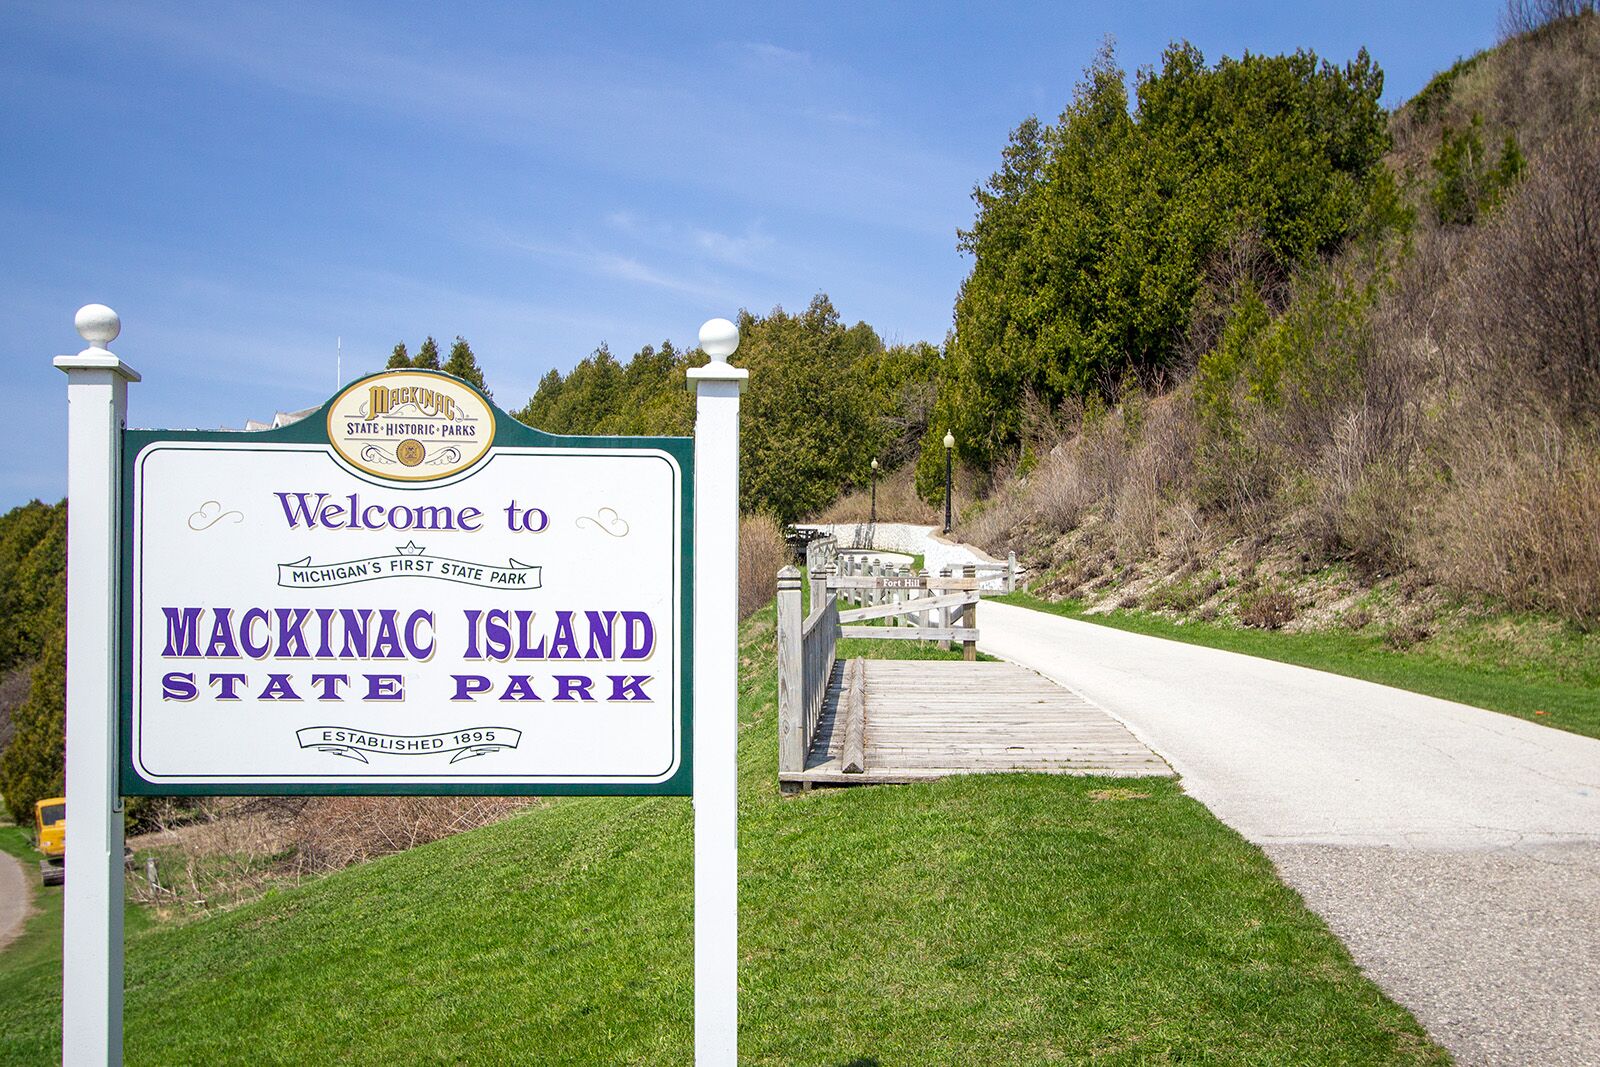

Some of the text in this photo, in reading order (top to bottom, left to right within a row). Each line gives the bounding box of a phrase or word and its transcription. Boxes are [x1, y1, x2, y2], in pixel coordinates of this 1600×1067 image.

[365, 385, 455, 421] MACKINAC
[347, 422, 476, 437] STATE HISTORIC PARKS
[273, 492, 550, 533] Welcome to
[292, 560, 527, 585] MICHIGAN'S FIRST STATE PARK
[883, 578, 920, 587] Fort Hill
[161, 607, 657, 662] MACKINAC ISLAND
[161, 672, 655, 703] STATE PARK
[323, 731, 495, 750] ESTABLISHED 1895
